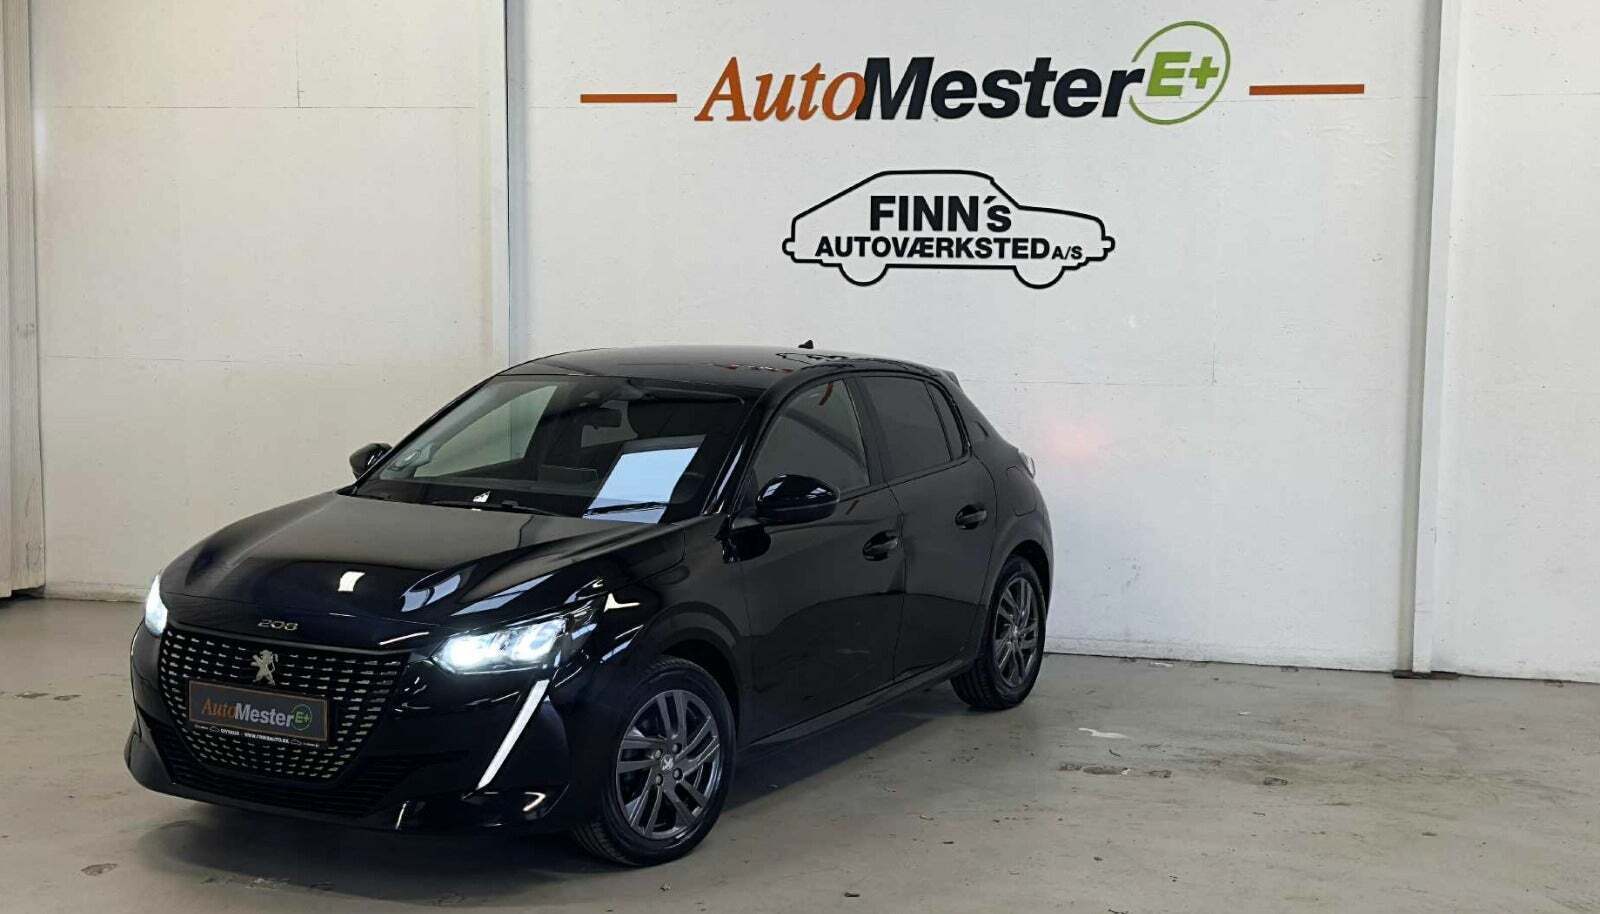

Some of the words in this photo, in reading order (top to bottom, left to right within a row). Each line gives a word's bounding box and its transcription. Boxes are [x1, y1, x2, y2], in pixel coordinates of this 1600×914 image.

[694, 56, 1146, 121] AutoMester
[815, 236, 1050, 259] AUTOVÆRKSTED
[1051, 245, 1083, 260] A/S
